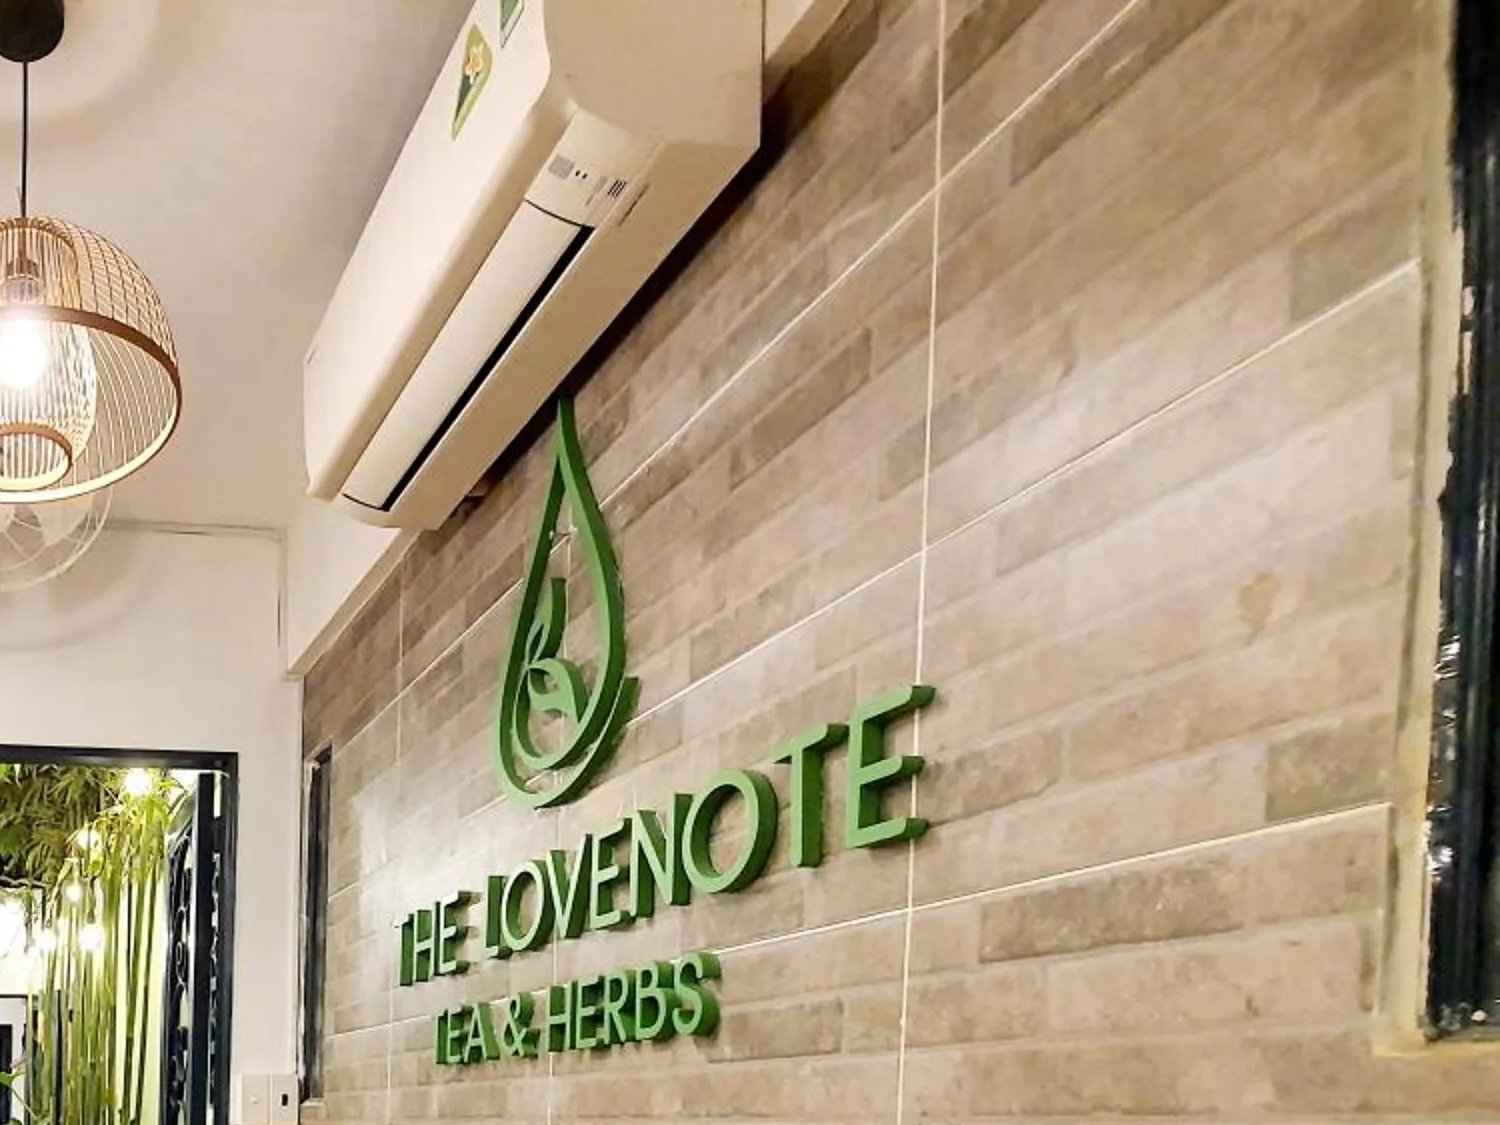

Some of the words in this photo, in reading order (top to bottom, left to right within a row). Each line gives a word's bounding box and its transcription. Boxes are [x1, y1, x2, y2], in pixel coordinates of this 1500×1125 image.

[395, 890, 476, 986] THE
[485, 685, 935, 958] LOVENOTE
[434, 1002, 500, 1064] TEA
[503, 991, 540, 1059] &
[545, 952, 721, 1053] HERBS
